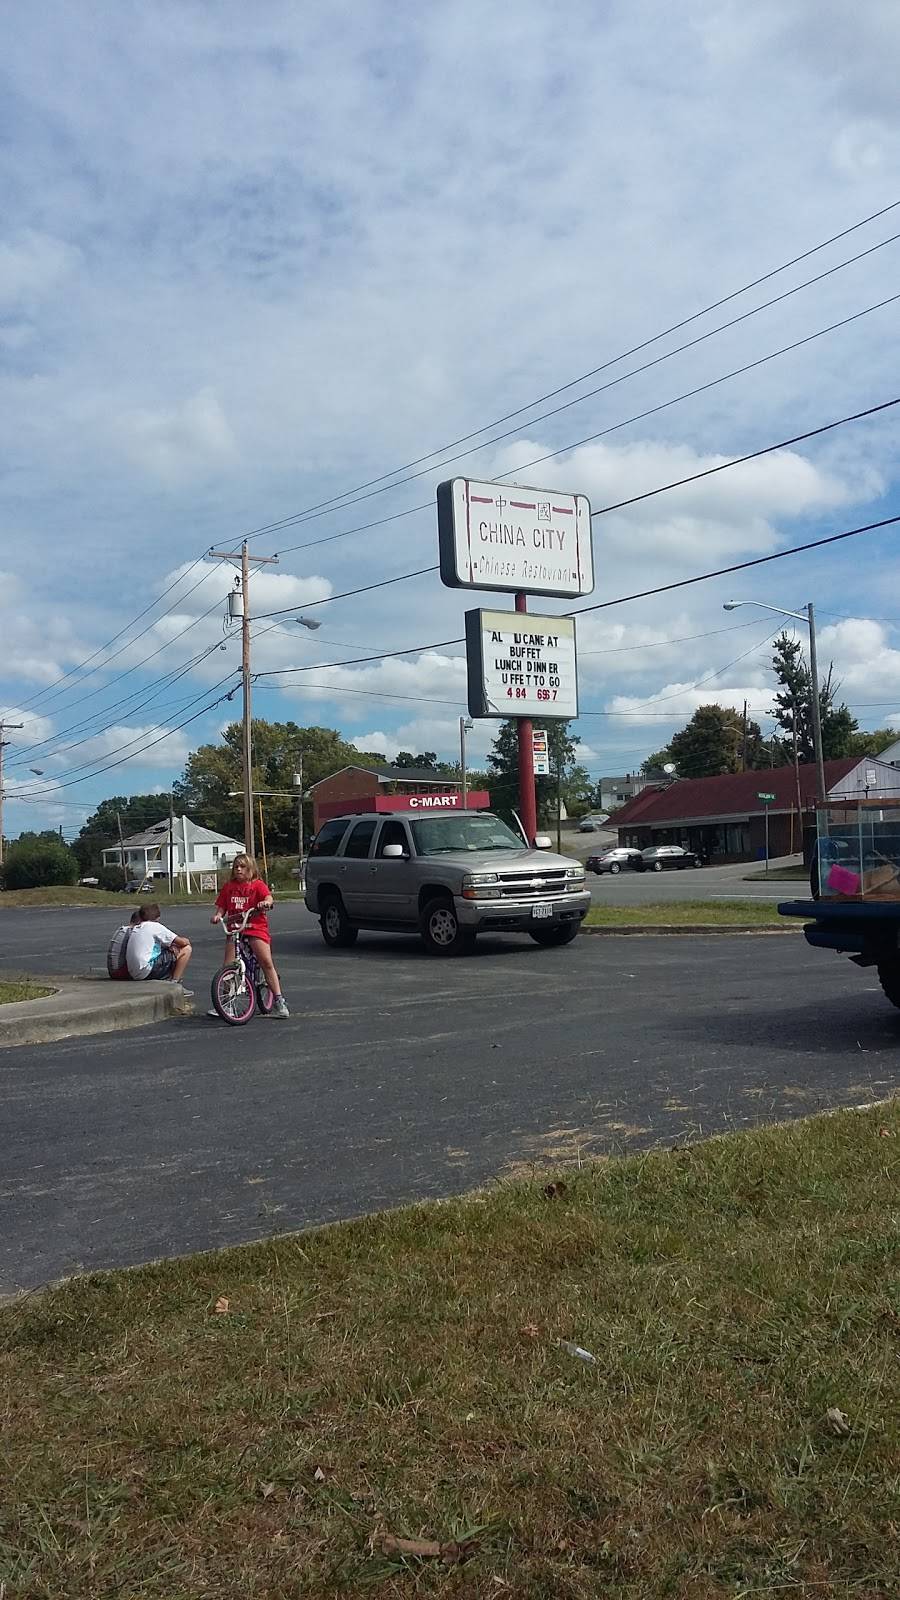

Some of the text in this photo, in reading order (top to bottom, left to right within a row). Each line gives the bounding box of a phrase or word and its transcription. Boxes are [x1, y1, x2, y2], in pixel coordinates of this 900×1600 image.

[495, 495, 507, 517] 中
[479, 521, 566, 551] CHINA CITY
[479, 555, 516, 577] Chinese
[509, 646, 541, 659] BUFFET
[495, 659, 558, 674] LUNCH DINNER
[533, 675, 545, 687] TO
[549, 676, 560, 688] GO
[409, 795, 458, 808] C-MART
